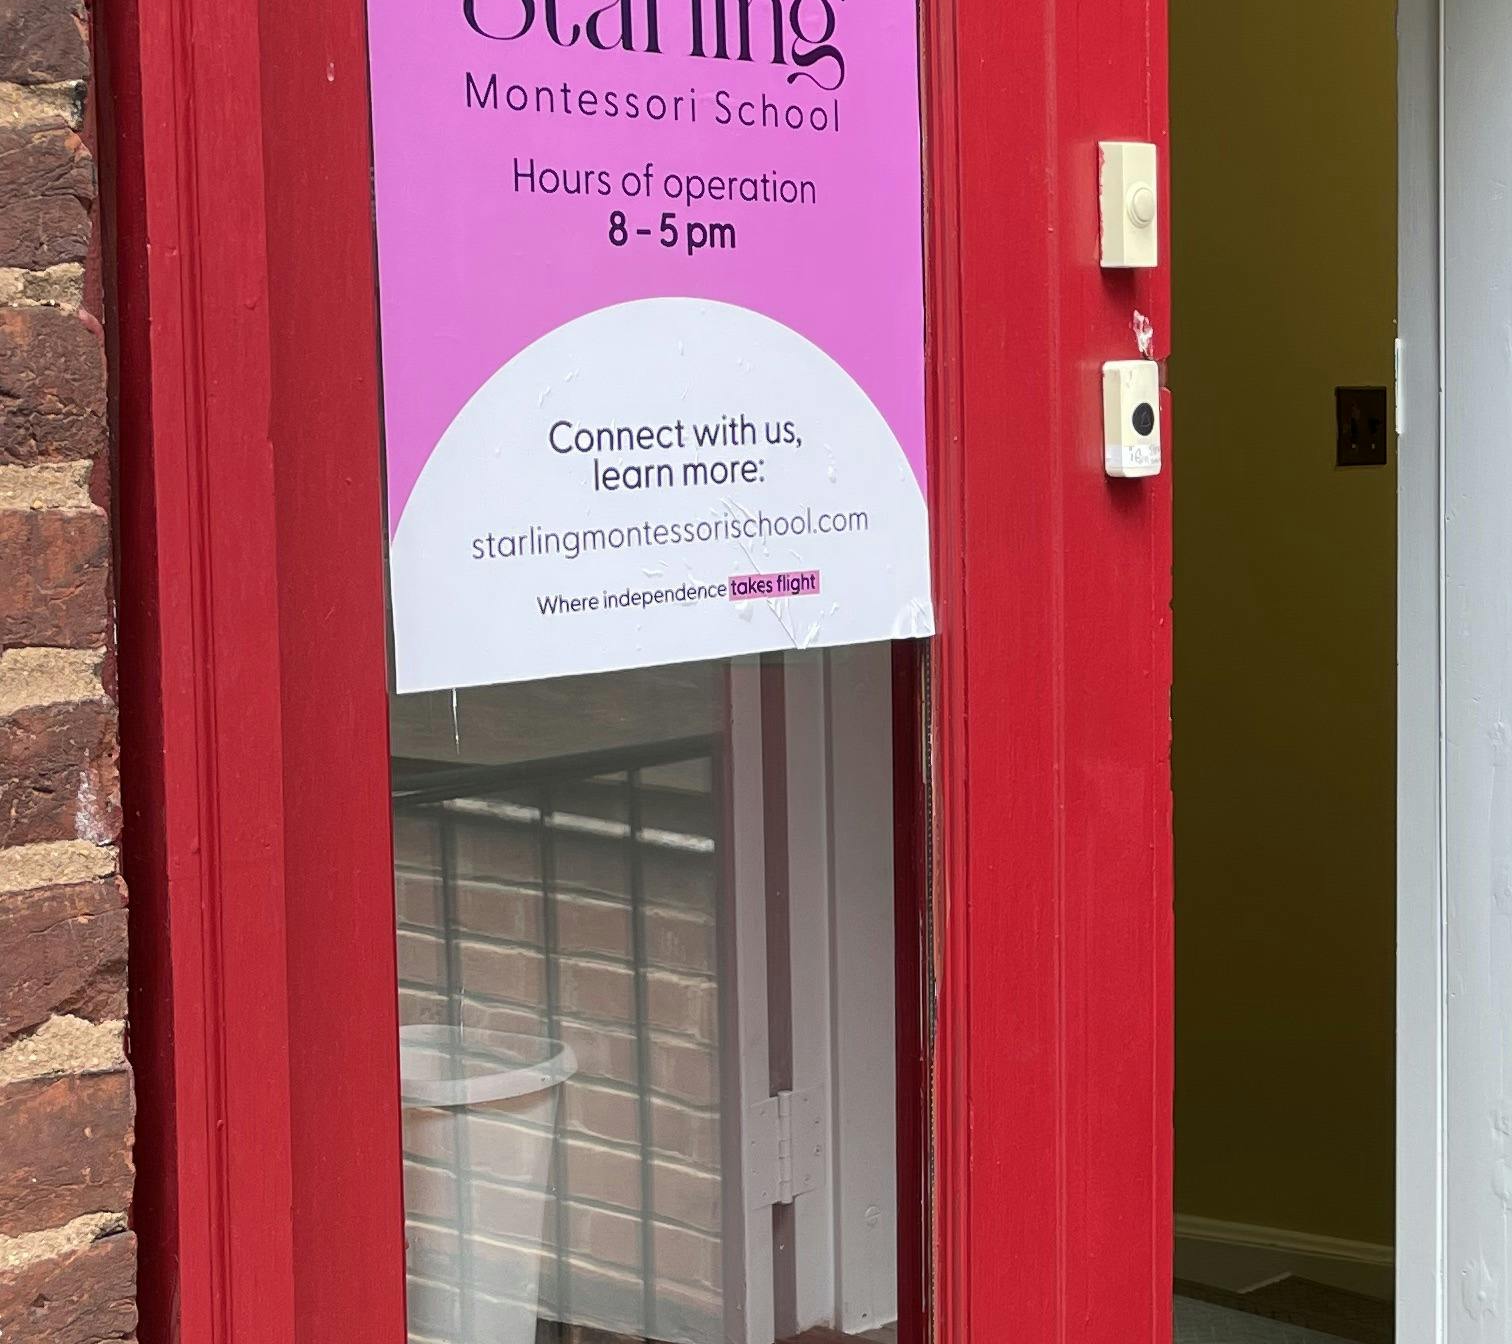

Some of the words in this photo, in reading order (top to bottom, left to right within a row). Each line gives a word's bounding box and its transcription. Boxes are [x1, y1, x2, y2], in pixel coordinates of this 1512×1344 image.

[464, 71, 697, 123] Montessori
[714, 90, 841, 132] School
[513, 157, 612, 196] Hours
[621, 162, 654, 197] of
[663, 169, 817, 207] operation
[549, 419, 685, 454] Connect
[692, 414, 758, 447] with
[765, 417, 802, 449] us,
[593, 458, 674, 492] learn
[682, 458, 766, 488] more:
[471, 506, 869, 560] starlingmontessorischool.com
[536, 594, 600, 616] Where
[602, 582, 728, 610] independence
[730, 575, 774, 597] takes
[776, 572, 817, 596] flight
